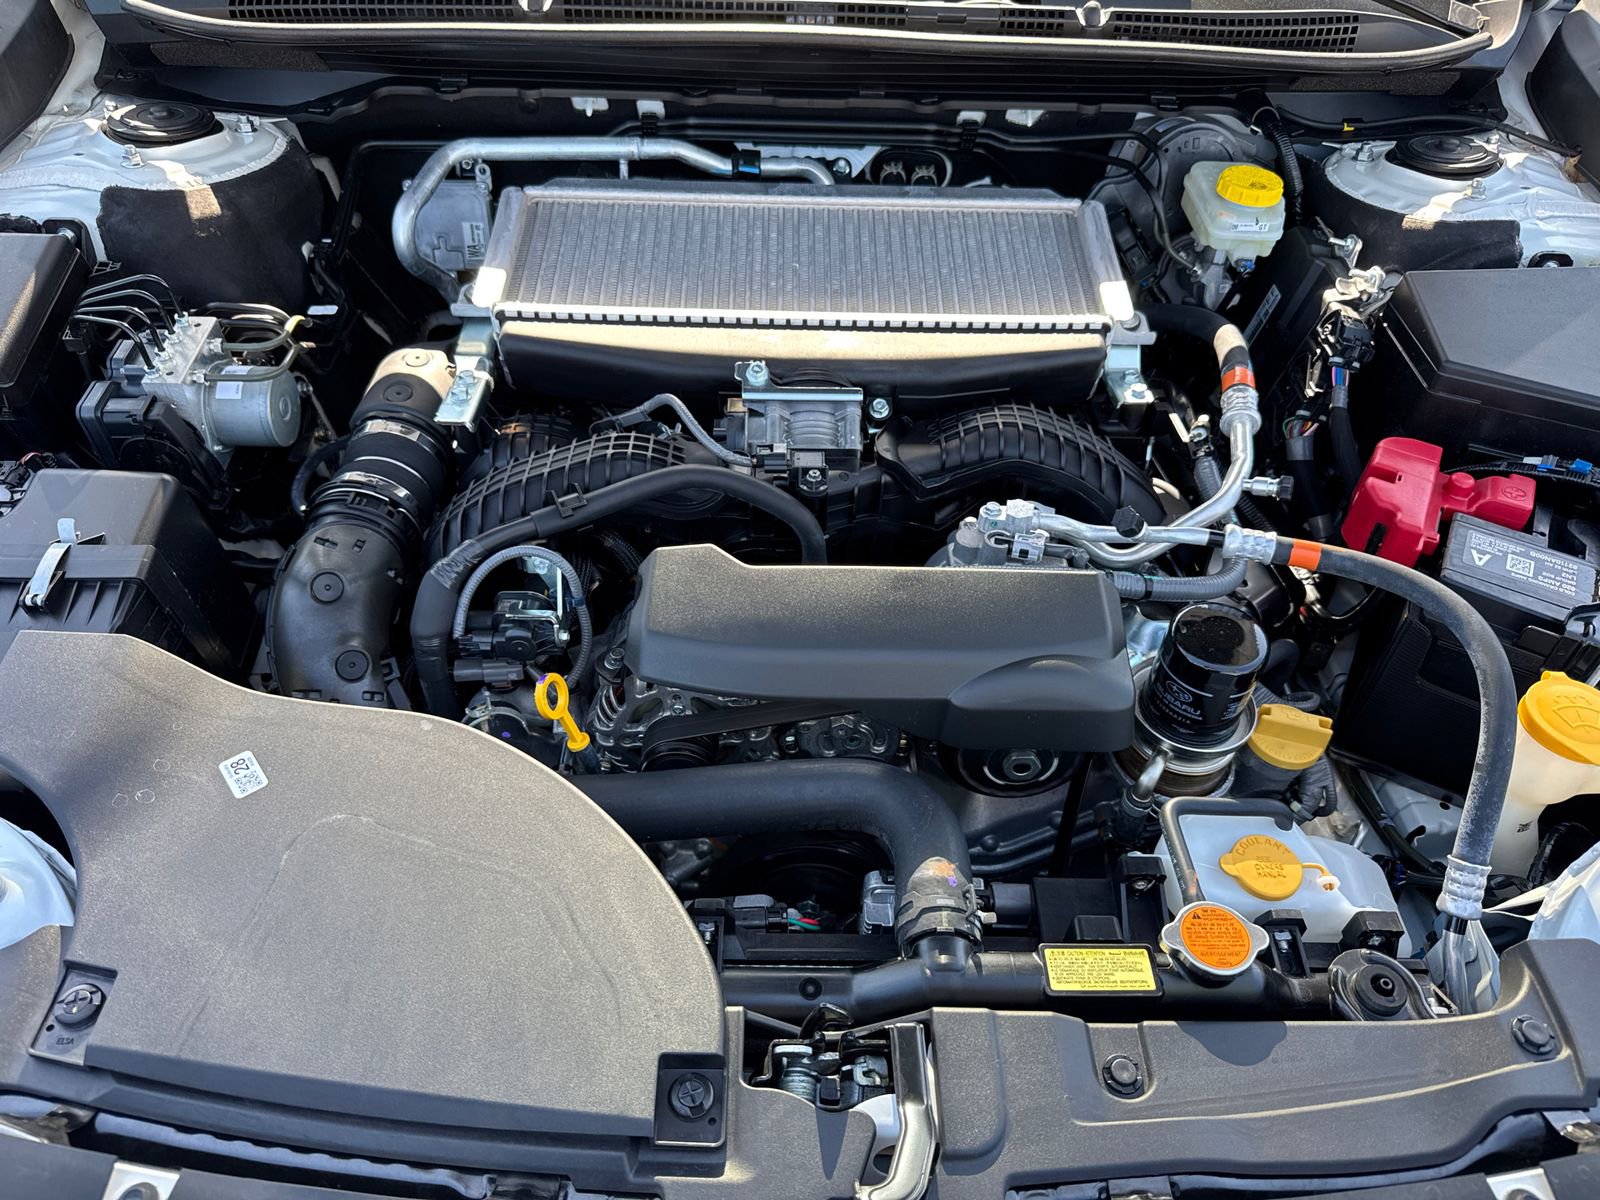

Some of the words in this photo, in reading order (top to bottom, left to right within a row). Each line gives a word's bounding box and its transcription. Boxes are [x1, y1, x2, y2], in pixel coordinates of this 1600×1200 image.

[466, 244, 480, 258] WA
[1471, 549, 1492, 566] A
[1511, 572, 1527, 580] AMPS
[1538, 575, 1561, 586] AMPS
[1527, 578, 1558, 591] CRANKING
[1157, 682, 1201, 715] SUBARU
[1235, 837, 1291, 856] COOLANT
[1257, 871, 1287, 879] MANUAL
